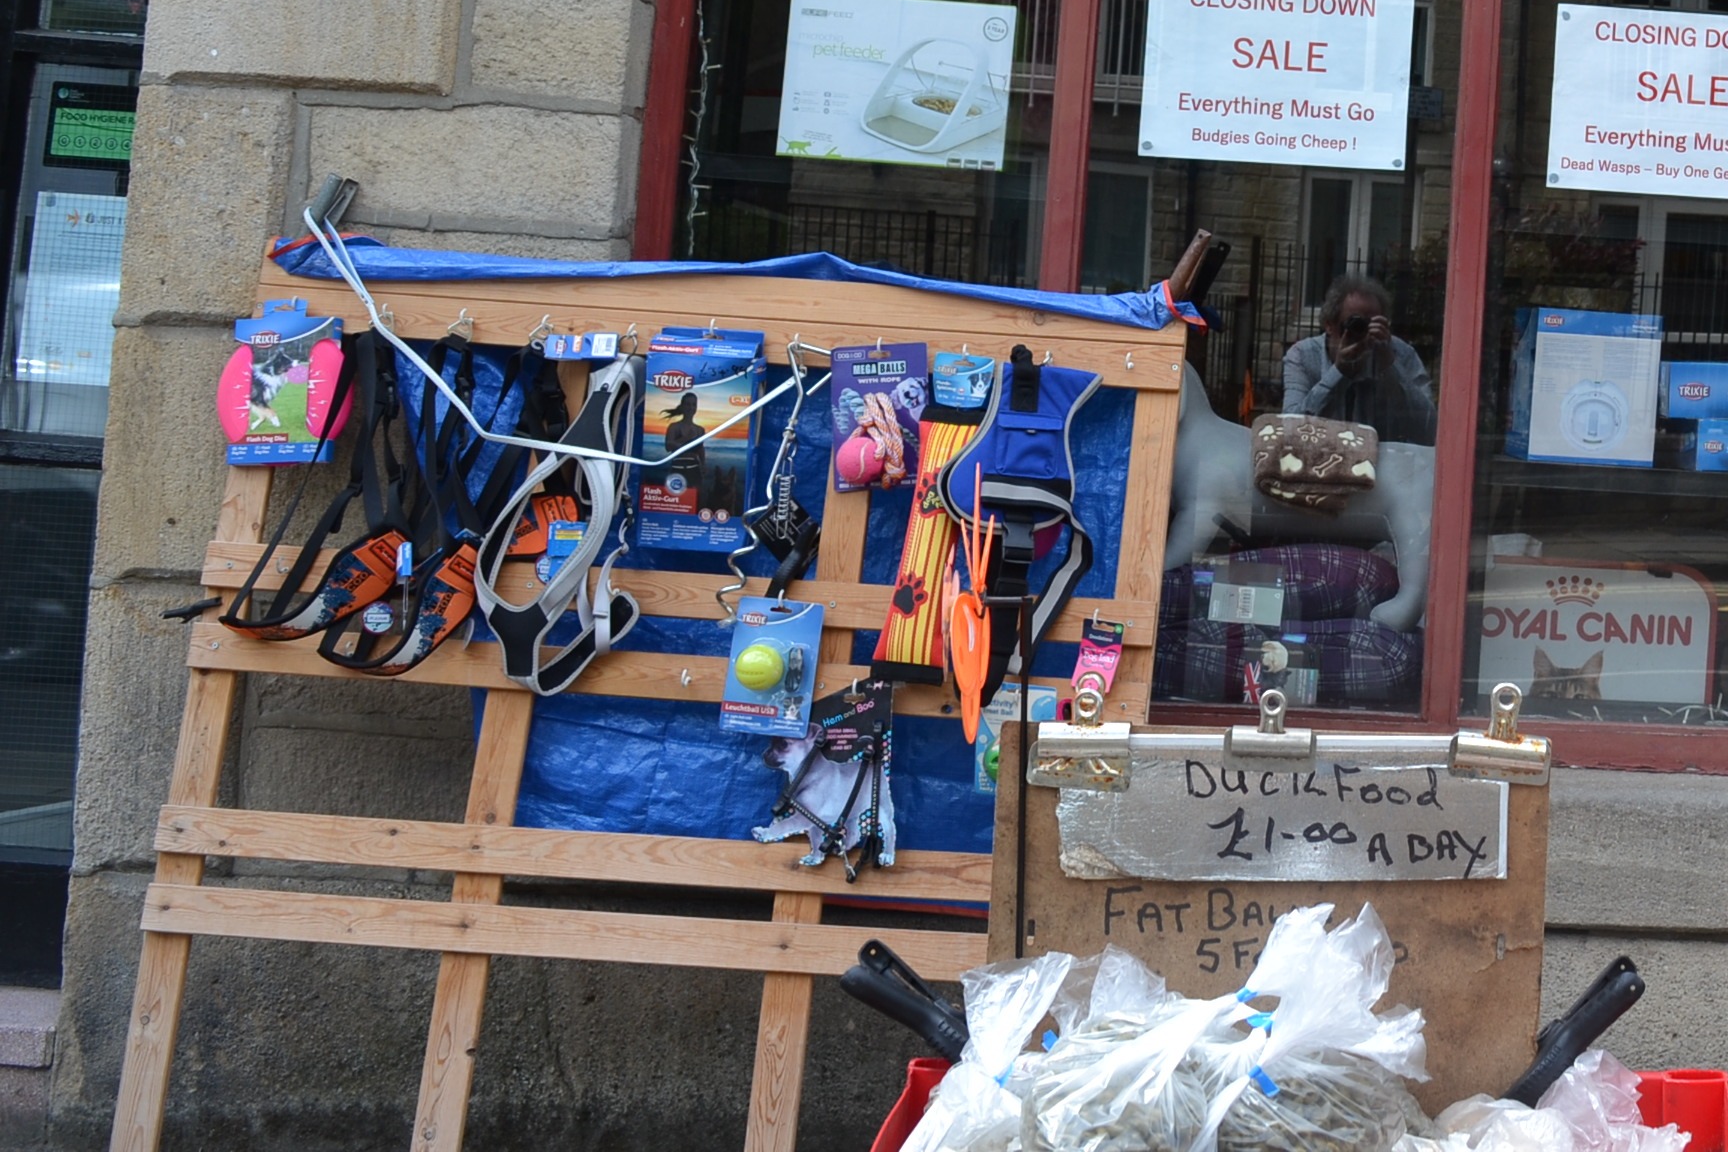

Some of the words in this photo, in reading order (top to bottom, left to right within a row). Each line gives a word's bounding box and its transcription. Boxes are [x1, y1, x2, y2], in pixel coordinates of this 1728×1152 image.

[1595, 21, 1697, 47] CLOSING
[812, 43, 837, 58] pet
[840, 42, 886, 59] feeder
[1232, 37, 1328, 73] SALE
[1178, 93, 1283, 120] Everything
[1291, 100, 1341, 120] Must
[1347, 103, 1375, 121] Go
[61, 112, 87, 121] FOOD
[1192, 128, 1250, 146] Budgies
[1254, 132, 1297, 149] Going
[1301, 135, 1348, 151] Cheep
[1585, 125, 1687, 153] Everything
[1561, 157, 1594, 171] Dead
[1599, 160, 1641, 175] Wasps
[1656, 163, 1680, 178] Buy
[1684, 166, 1709, 179] One
[250, 334, 281, 345] TRIXIE
[853, 363, 877, 375] MEGA
[879, 361, 905, 373] BALLS
[653, 375, 693, 389] TRIXIE
[1679, 386, 1709, 397] TRIXIE
[1704, 443, 1722, 451] TRIXIE
[644, 487, 662, 495] Flash
[743, 615, 766, 624] TRIXIE
[1481, 606, 1567, 641] OYAL
[1576, 612, 1692, 646] CANIN
[760, 707, 775, 715] USB
[990, 698, 1014, 708] ctivity
[823, 714, 843, 727] Hem
[856, 700, 875, 713] Boo
[1367, 832, 1393, 865] A
[1104, 885, 1192, 935] FAT
